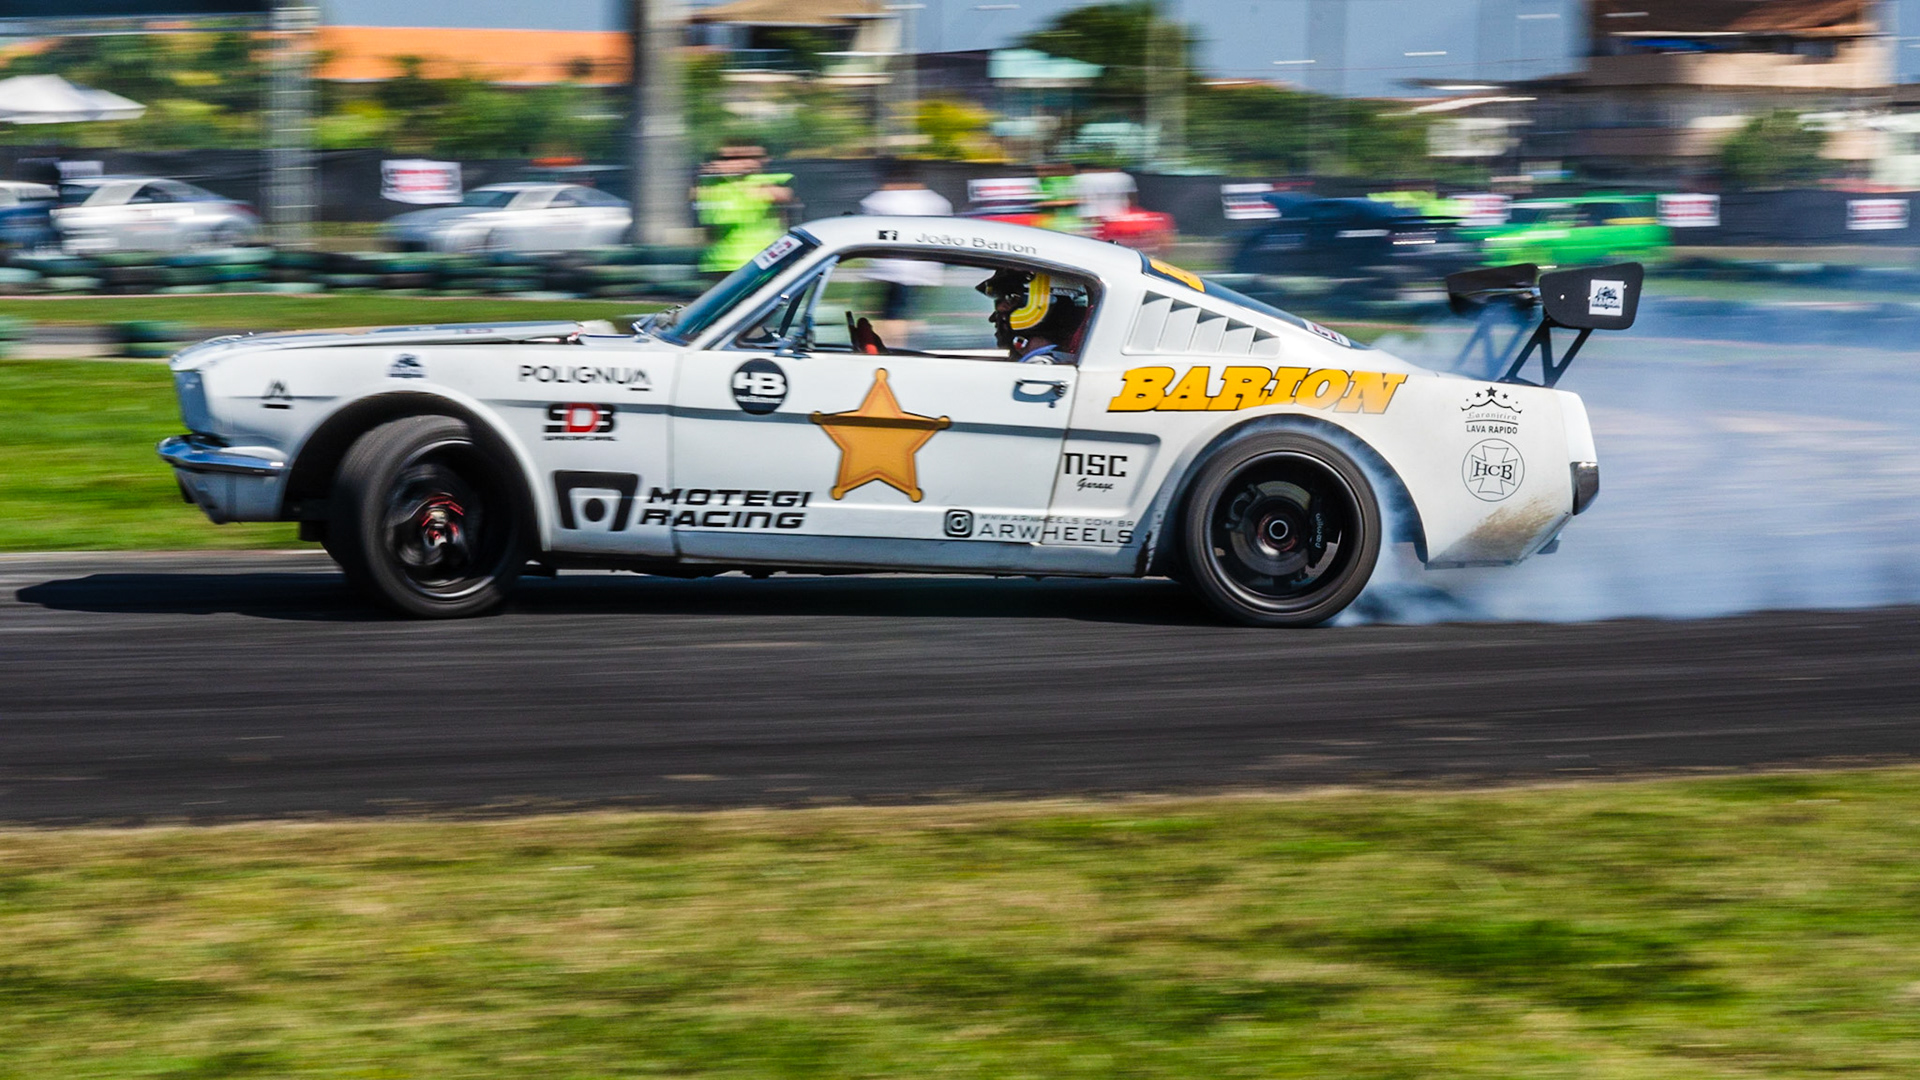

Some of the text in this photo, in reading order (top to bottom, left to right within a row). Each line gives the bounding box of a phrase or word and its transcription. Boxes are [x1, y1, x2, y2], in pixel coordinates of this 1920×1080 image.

[915, 232, 1037, 255] João Barion
[1106, 366, 1408, 415] BARION
[1466, 424, 1518, 435] LAVA RÁPIDO
[1473, 460, 1513, 480] HCB
[1077, 477, 1115, 492] Garage
[648, 487, 814, 508] MOTEGI
[639, 508, 807, 529] RACING
[978, 523, 1134, 545] ARWHEELS
